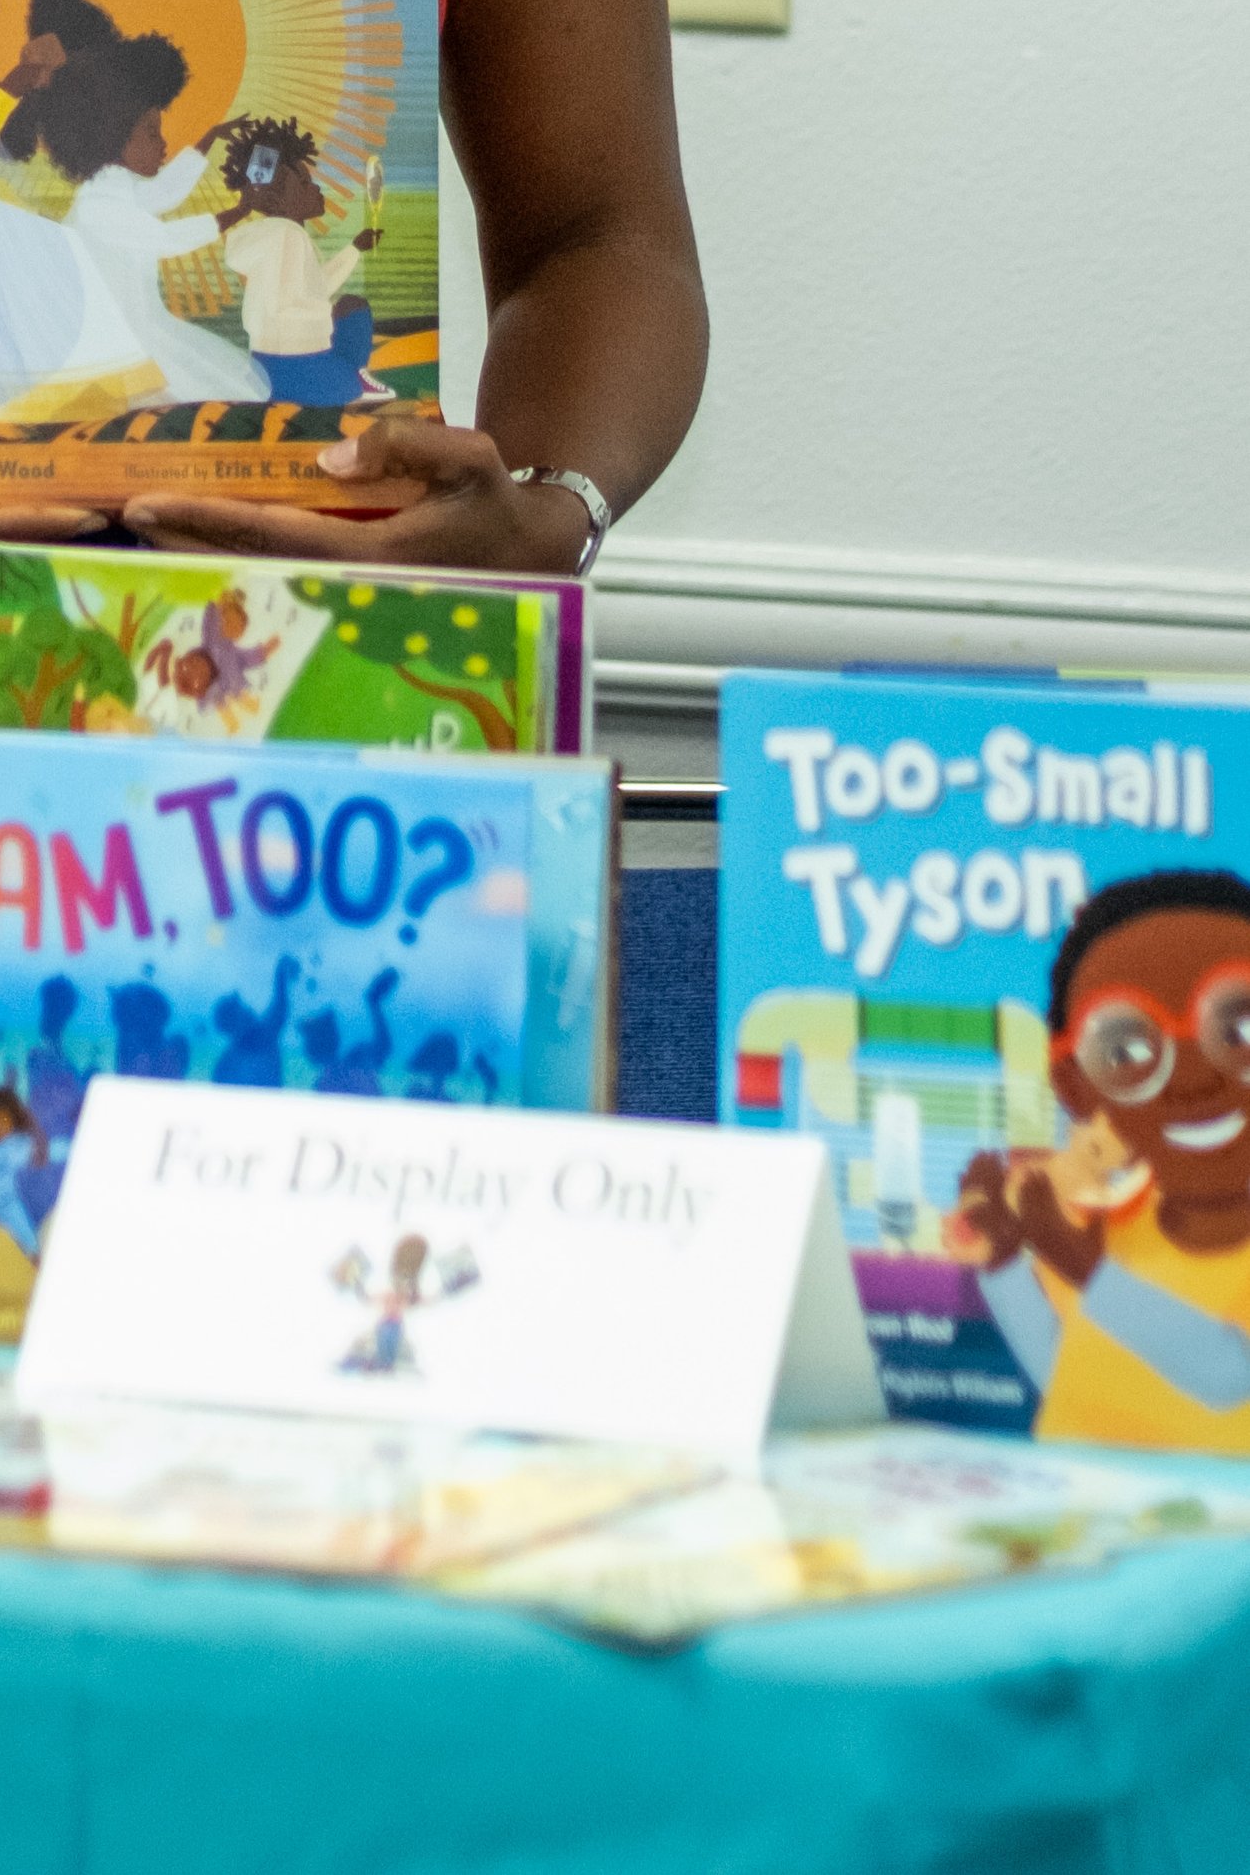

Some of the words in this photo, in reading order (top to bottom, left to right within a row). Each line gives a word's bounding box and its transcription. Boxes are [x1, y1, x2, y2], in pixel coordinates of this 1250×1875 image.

[762, 725, 1212, 839] Too-Small
[154, 777, 476, 946] TOO?
[780, 843, 1087, 979] Tyson
[153, 1124, 263, 1190] For
[287, 1133, 524, 1231] Display
[551, 1157, 715, 1245] Only
